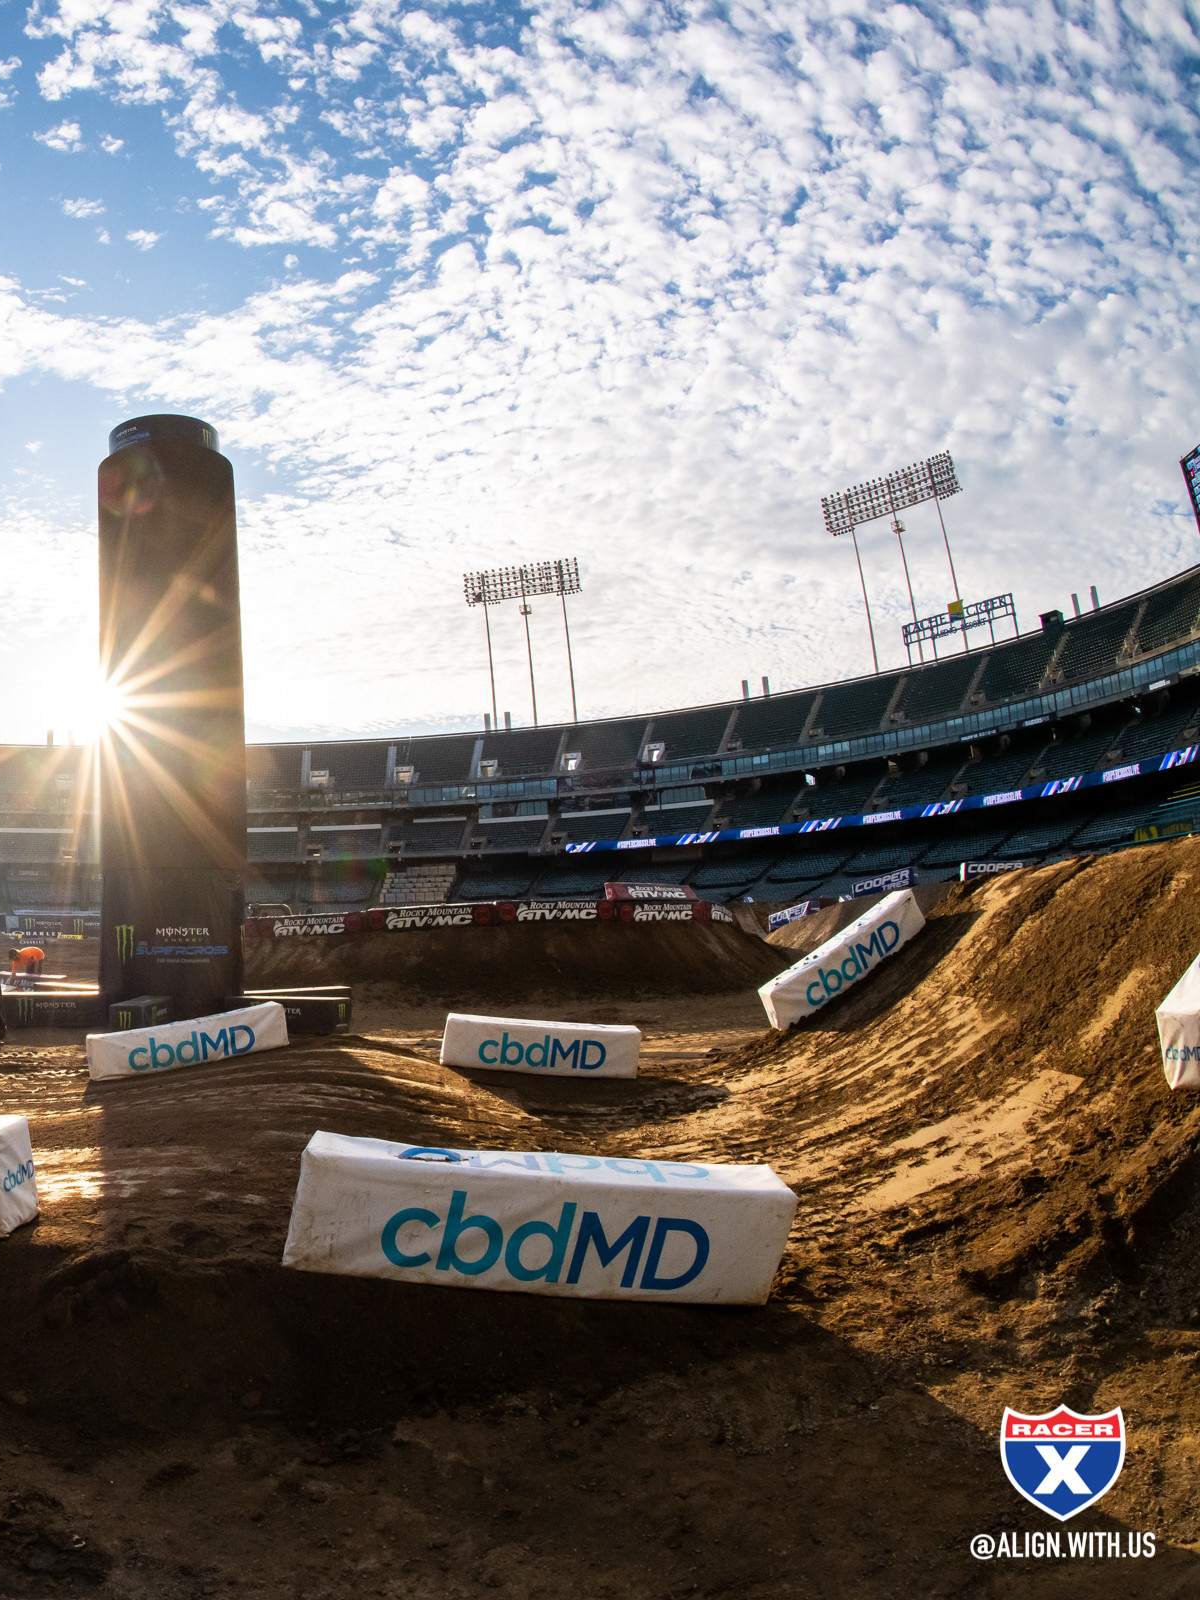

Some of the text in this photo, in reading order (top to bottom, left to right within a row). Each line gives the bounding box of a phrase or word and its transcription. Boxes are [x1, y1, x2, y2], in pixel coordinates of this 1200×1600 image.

[855, 869, 910, 892] COOPER
[882, 878, 910, 891] TIRES
[399, 907, 472, 917] ROCKY MOUNTAIN
[530, 901, 598, 910] ROCKY MOUNTAIN
[283, 916, 345, 926] ROCKY MOUNTAIN
[155, 926, 210, 937] MONSTER
[136, 945, 229, 956] SUPERCROSS
[806, 921, 900, 1005] cbdMD
[36, 1001, 77, 1009] MONSTER
[129, 1025, 255, 1071] cbdMD
[478, 1032, 607, 1070] cbdMD
[3, 1159, 34, 1192] cbdMD
[381, 1190, 711, 1291] cbdMD
